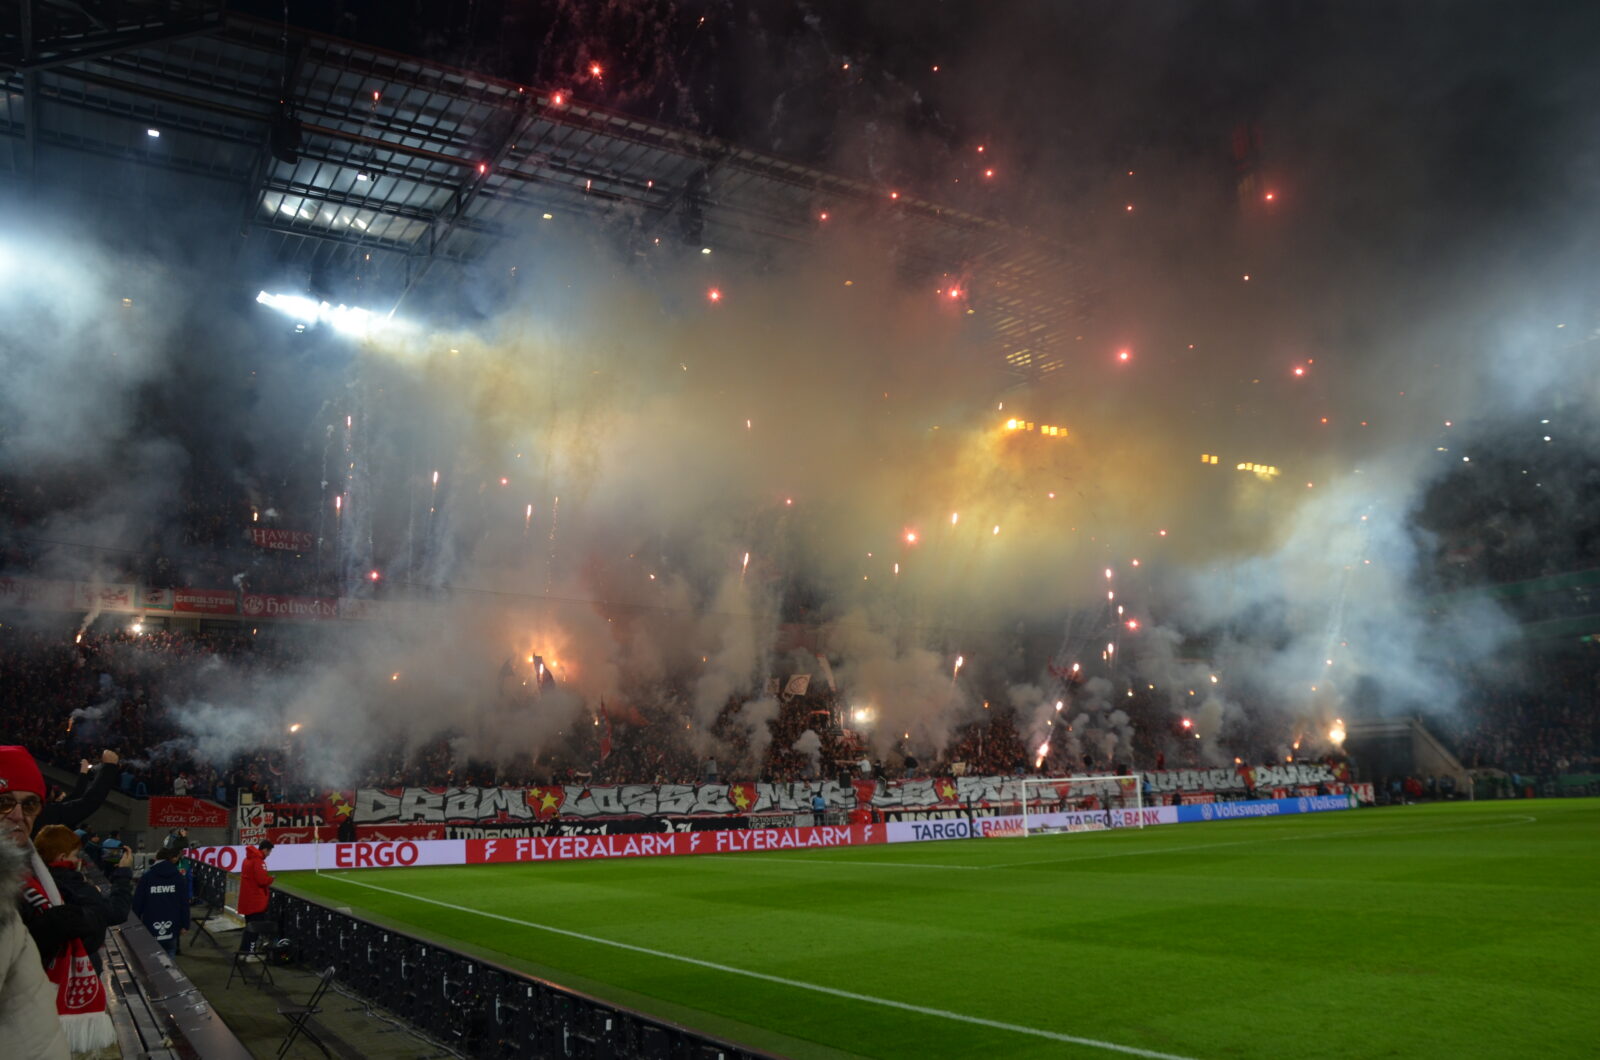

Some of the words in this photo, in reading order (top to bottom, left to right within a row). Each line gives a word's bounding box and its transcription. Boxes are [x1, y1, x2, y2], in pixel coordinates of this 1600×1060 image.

[253, 529, 312, 548] HAWKS
[267, 597, 337, 616] Holweide
[1213, 801, 1279, 817] Volkswagen
[1309, 795, 1349, 810] Volkswa
[1124, 807, 1160, 826] BANK
[717, 826, 851, 852] FLYERALARM
[912, 821, 968, 839] TARGO
[335, 842, 419, 868] ERGO
[516, 833, 675, 860] FLYERALARM
[150, 885, 176, 894] REWE
